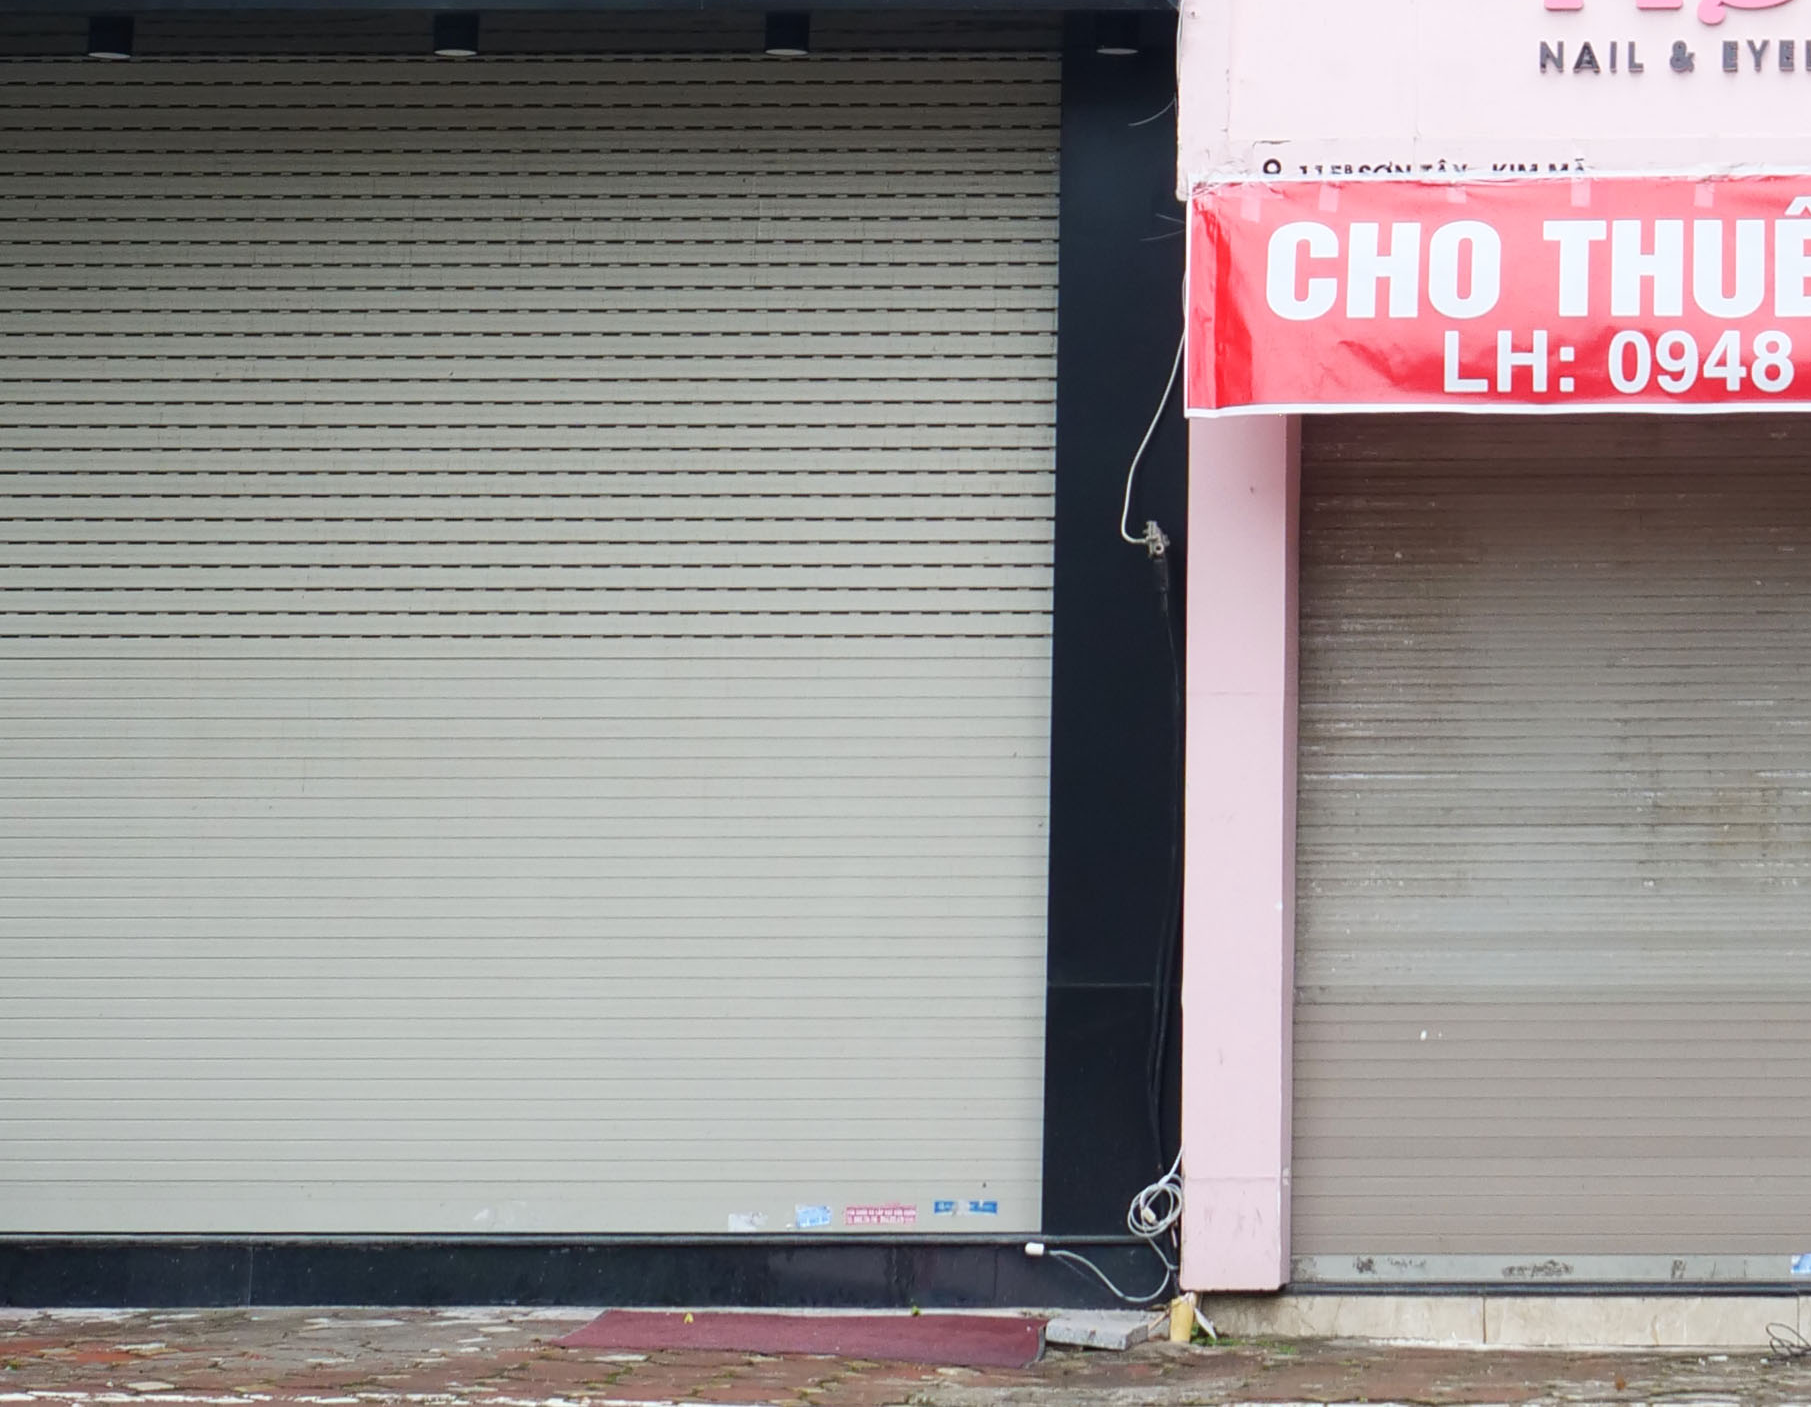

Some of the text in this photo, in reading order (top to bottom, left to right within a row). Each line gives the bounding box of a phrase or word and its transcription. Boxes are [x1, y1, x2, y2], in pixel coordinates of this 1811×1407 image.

[1539, 40, 1644, 73] NAIL
[1669, 40, 1695, 72] &
[1266, 220, 1501, 320] CHO
[1444, 330, 1575, 393] LH:
[1608, 330, 1795, 395] 0948
